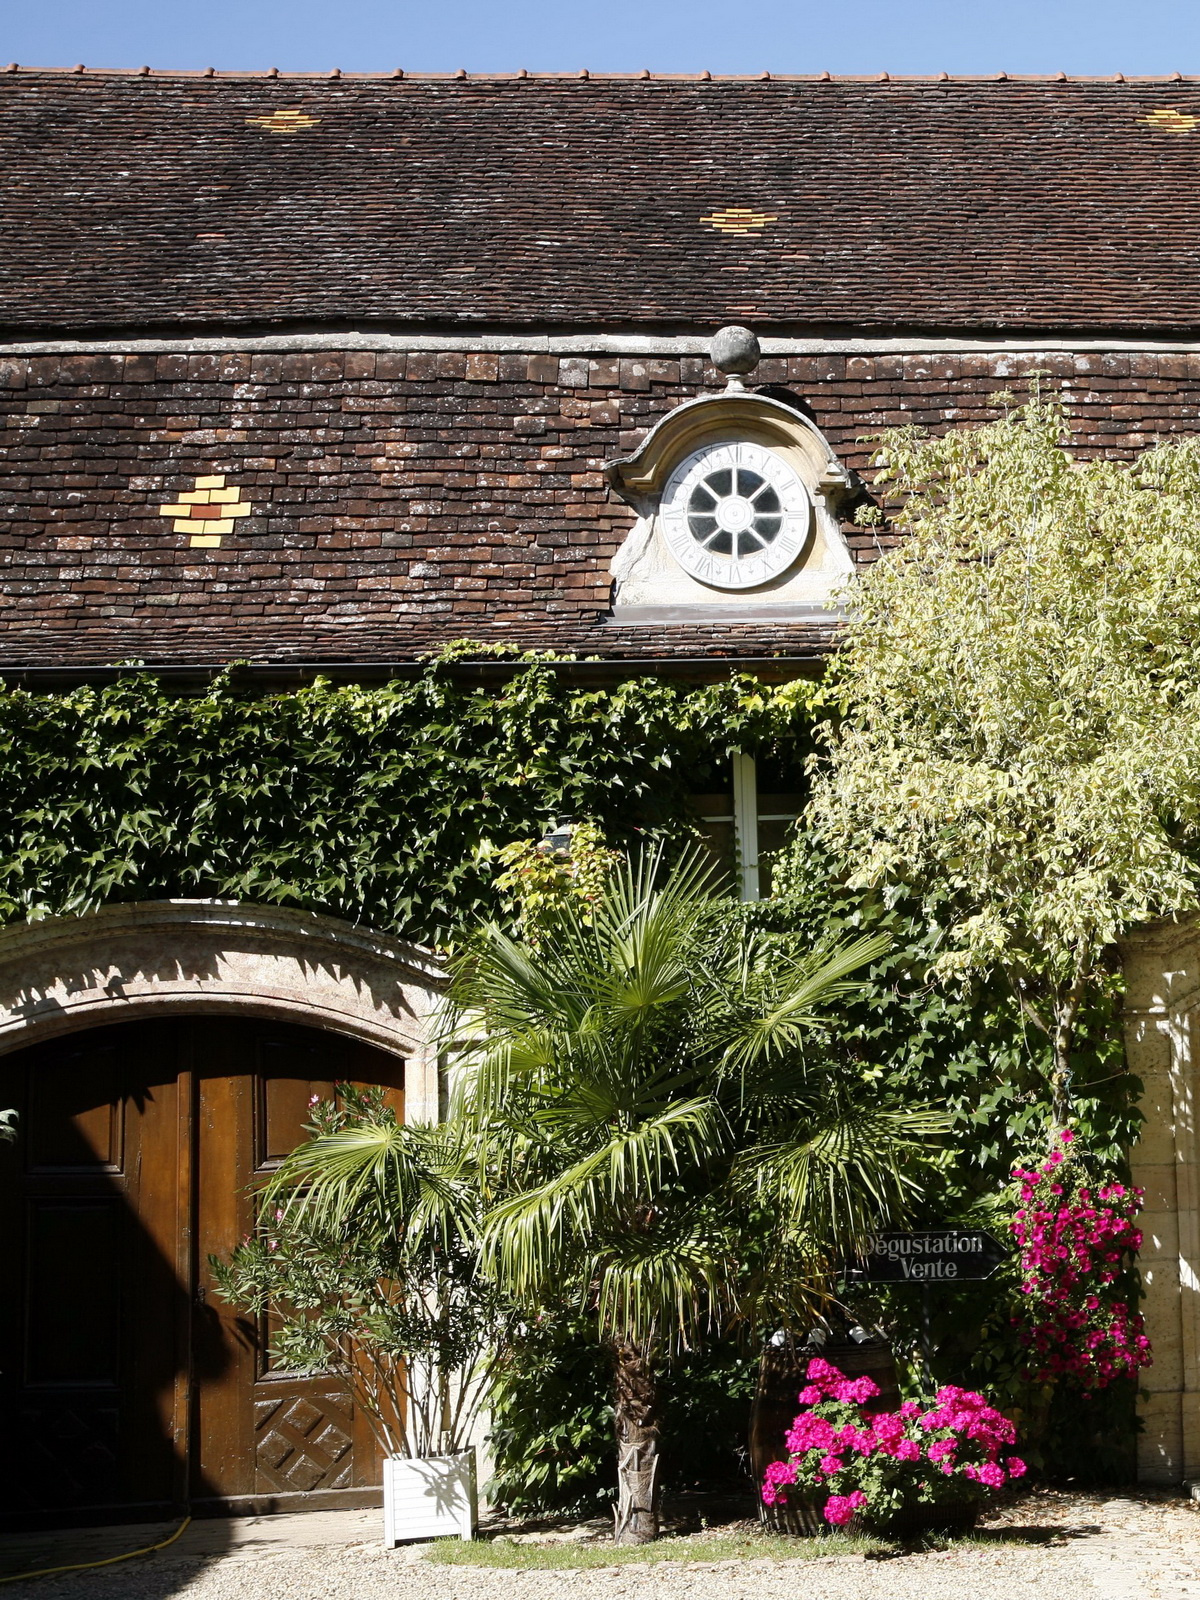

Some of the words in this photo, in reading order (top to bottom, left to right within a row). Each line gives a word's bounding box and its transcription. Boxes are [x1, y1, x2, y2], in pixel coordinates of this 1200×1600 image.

[726, 446, 743, 463] XII
[788, 510, 804, 519] III
[900, 1257, 958, 1279] Vente
